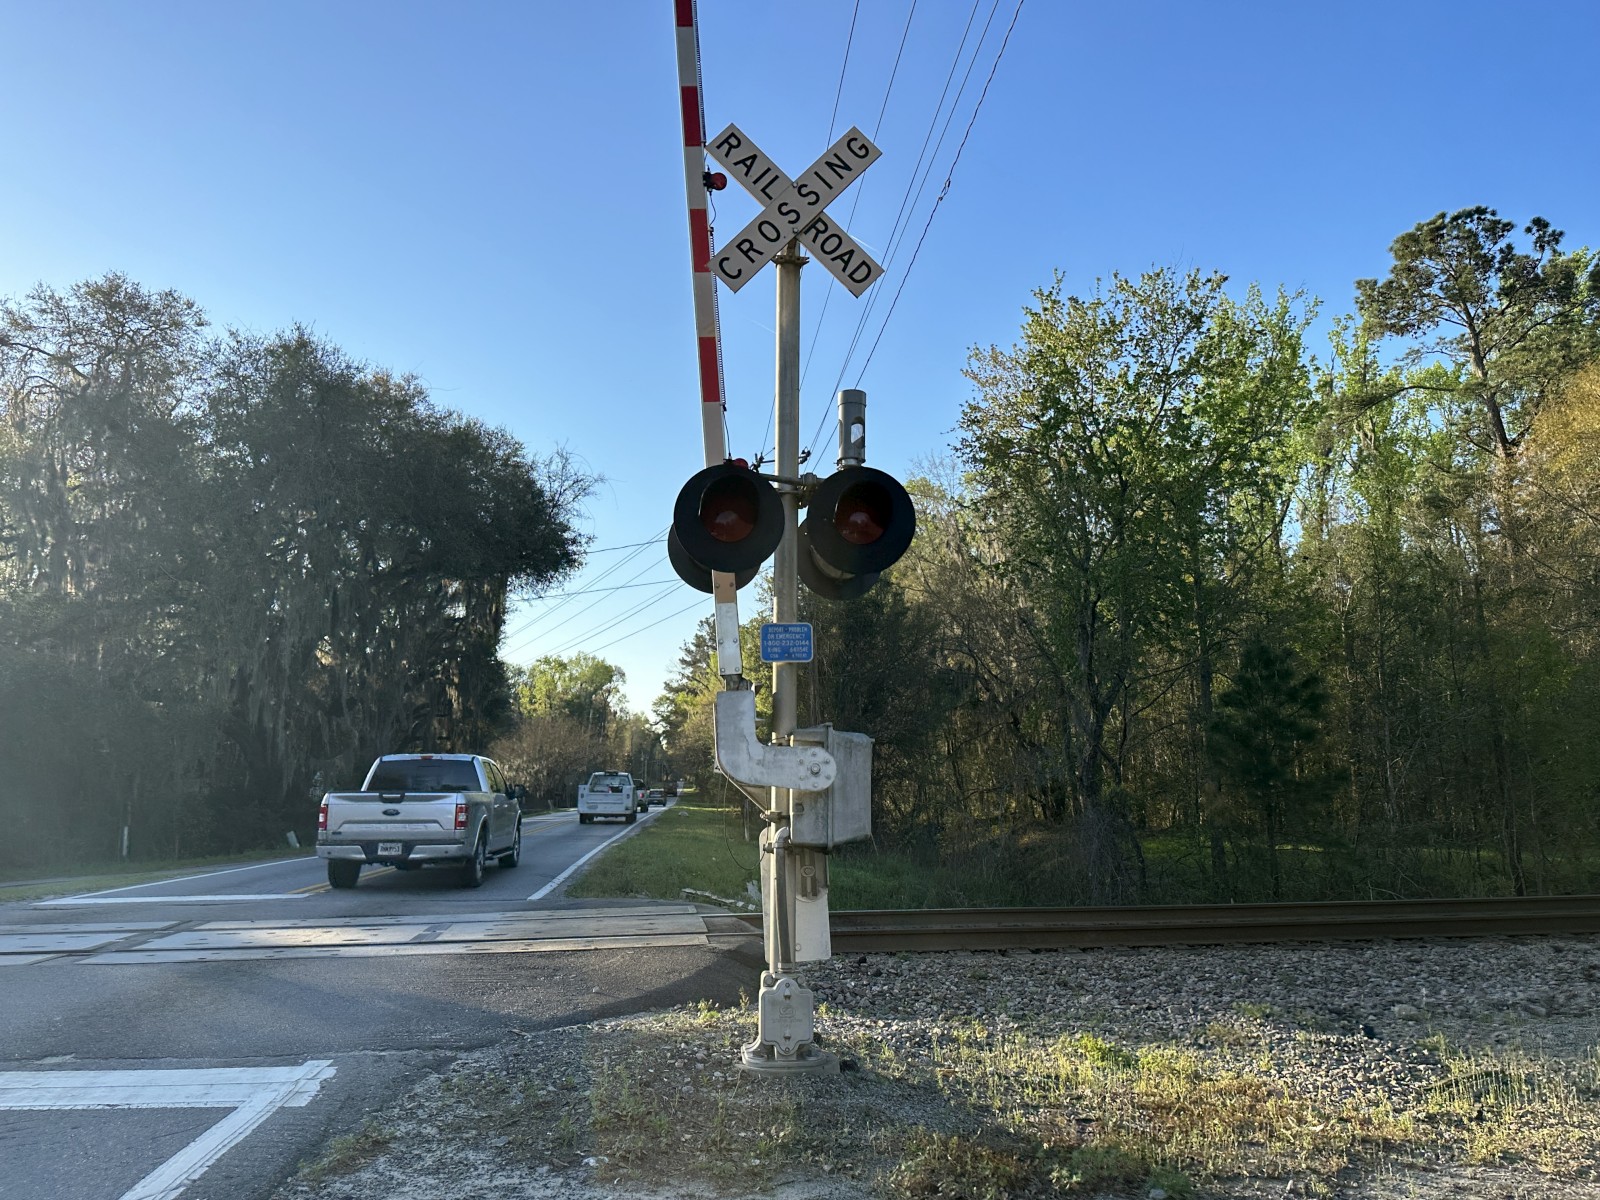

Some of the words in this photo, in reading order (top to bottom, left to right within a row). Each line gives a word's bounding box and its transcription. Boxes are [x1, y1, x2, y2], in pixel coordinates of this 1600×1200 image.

[716, 132, 780, 201] RAIL
[718, 137, 869, 280] CROSSING
[803, 216, 872, 284] ROAD
